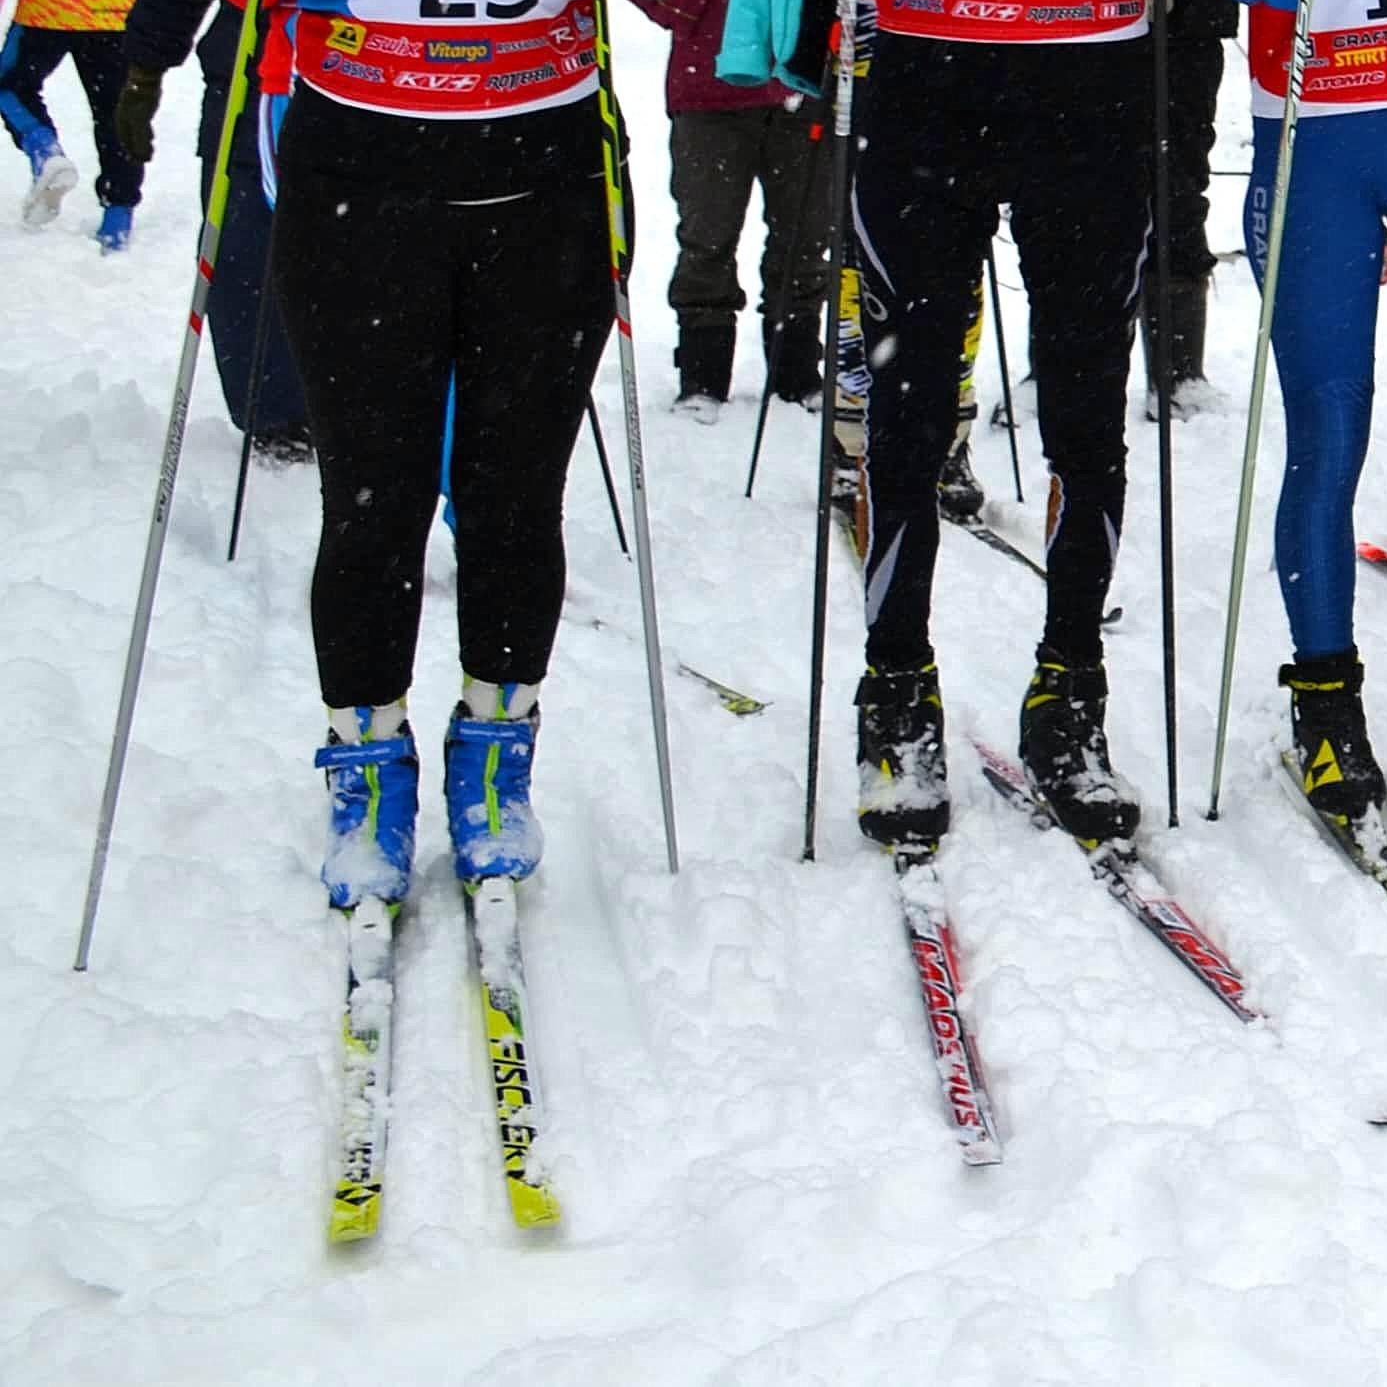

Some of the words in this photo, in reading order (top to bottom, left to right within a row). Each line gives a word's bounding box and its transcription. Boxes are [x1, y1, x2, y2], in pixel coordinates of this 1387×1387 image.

[428, 43, 489, 62] Vitargo
[1306, 71, 1386, 91] ATOMIC
[489, 1038, 538, 1160] FISCER
